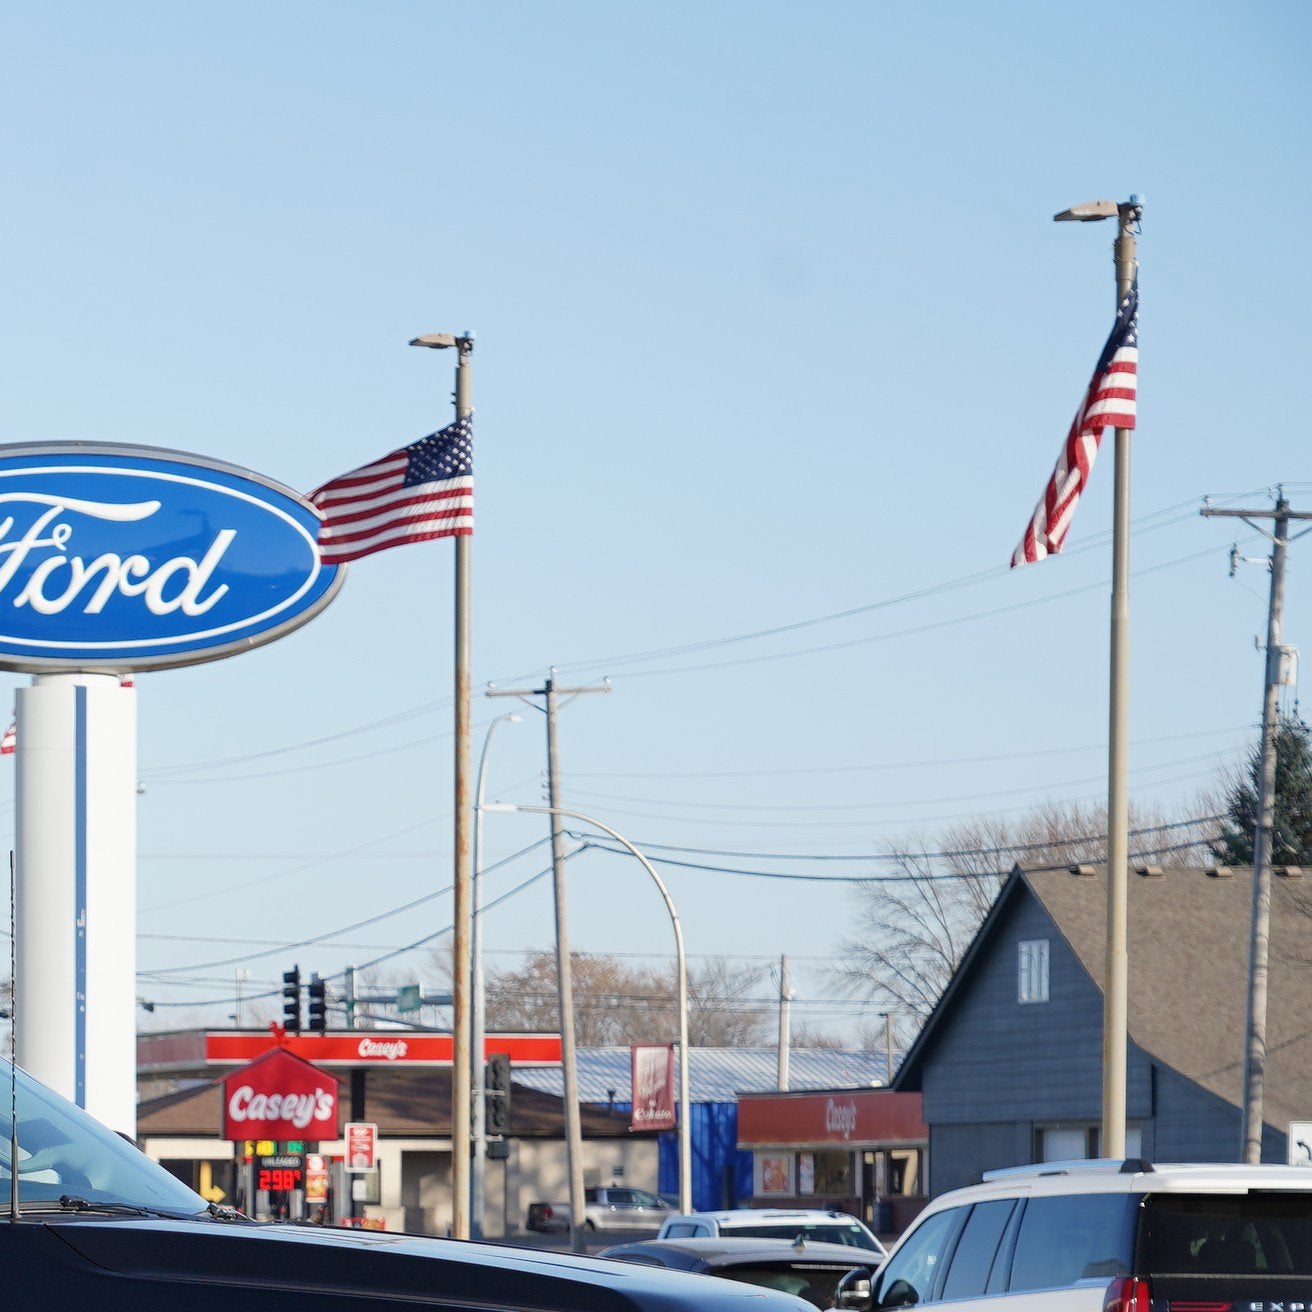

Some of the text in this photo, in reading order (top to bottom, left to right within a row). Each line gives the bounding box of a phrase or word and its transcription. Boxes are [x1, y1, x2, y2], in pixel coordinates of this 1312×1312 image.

[357, 1038, 408, 1060] Casey's
[229, 1085, 335, 1129] Casey's
[826, 1098, 857, 1140] Casey's
